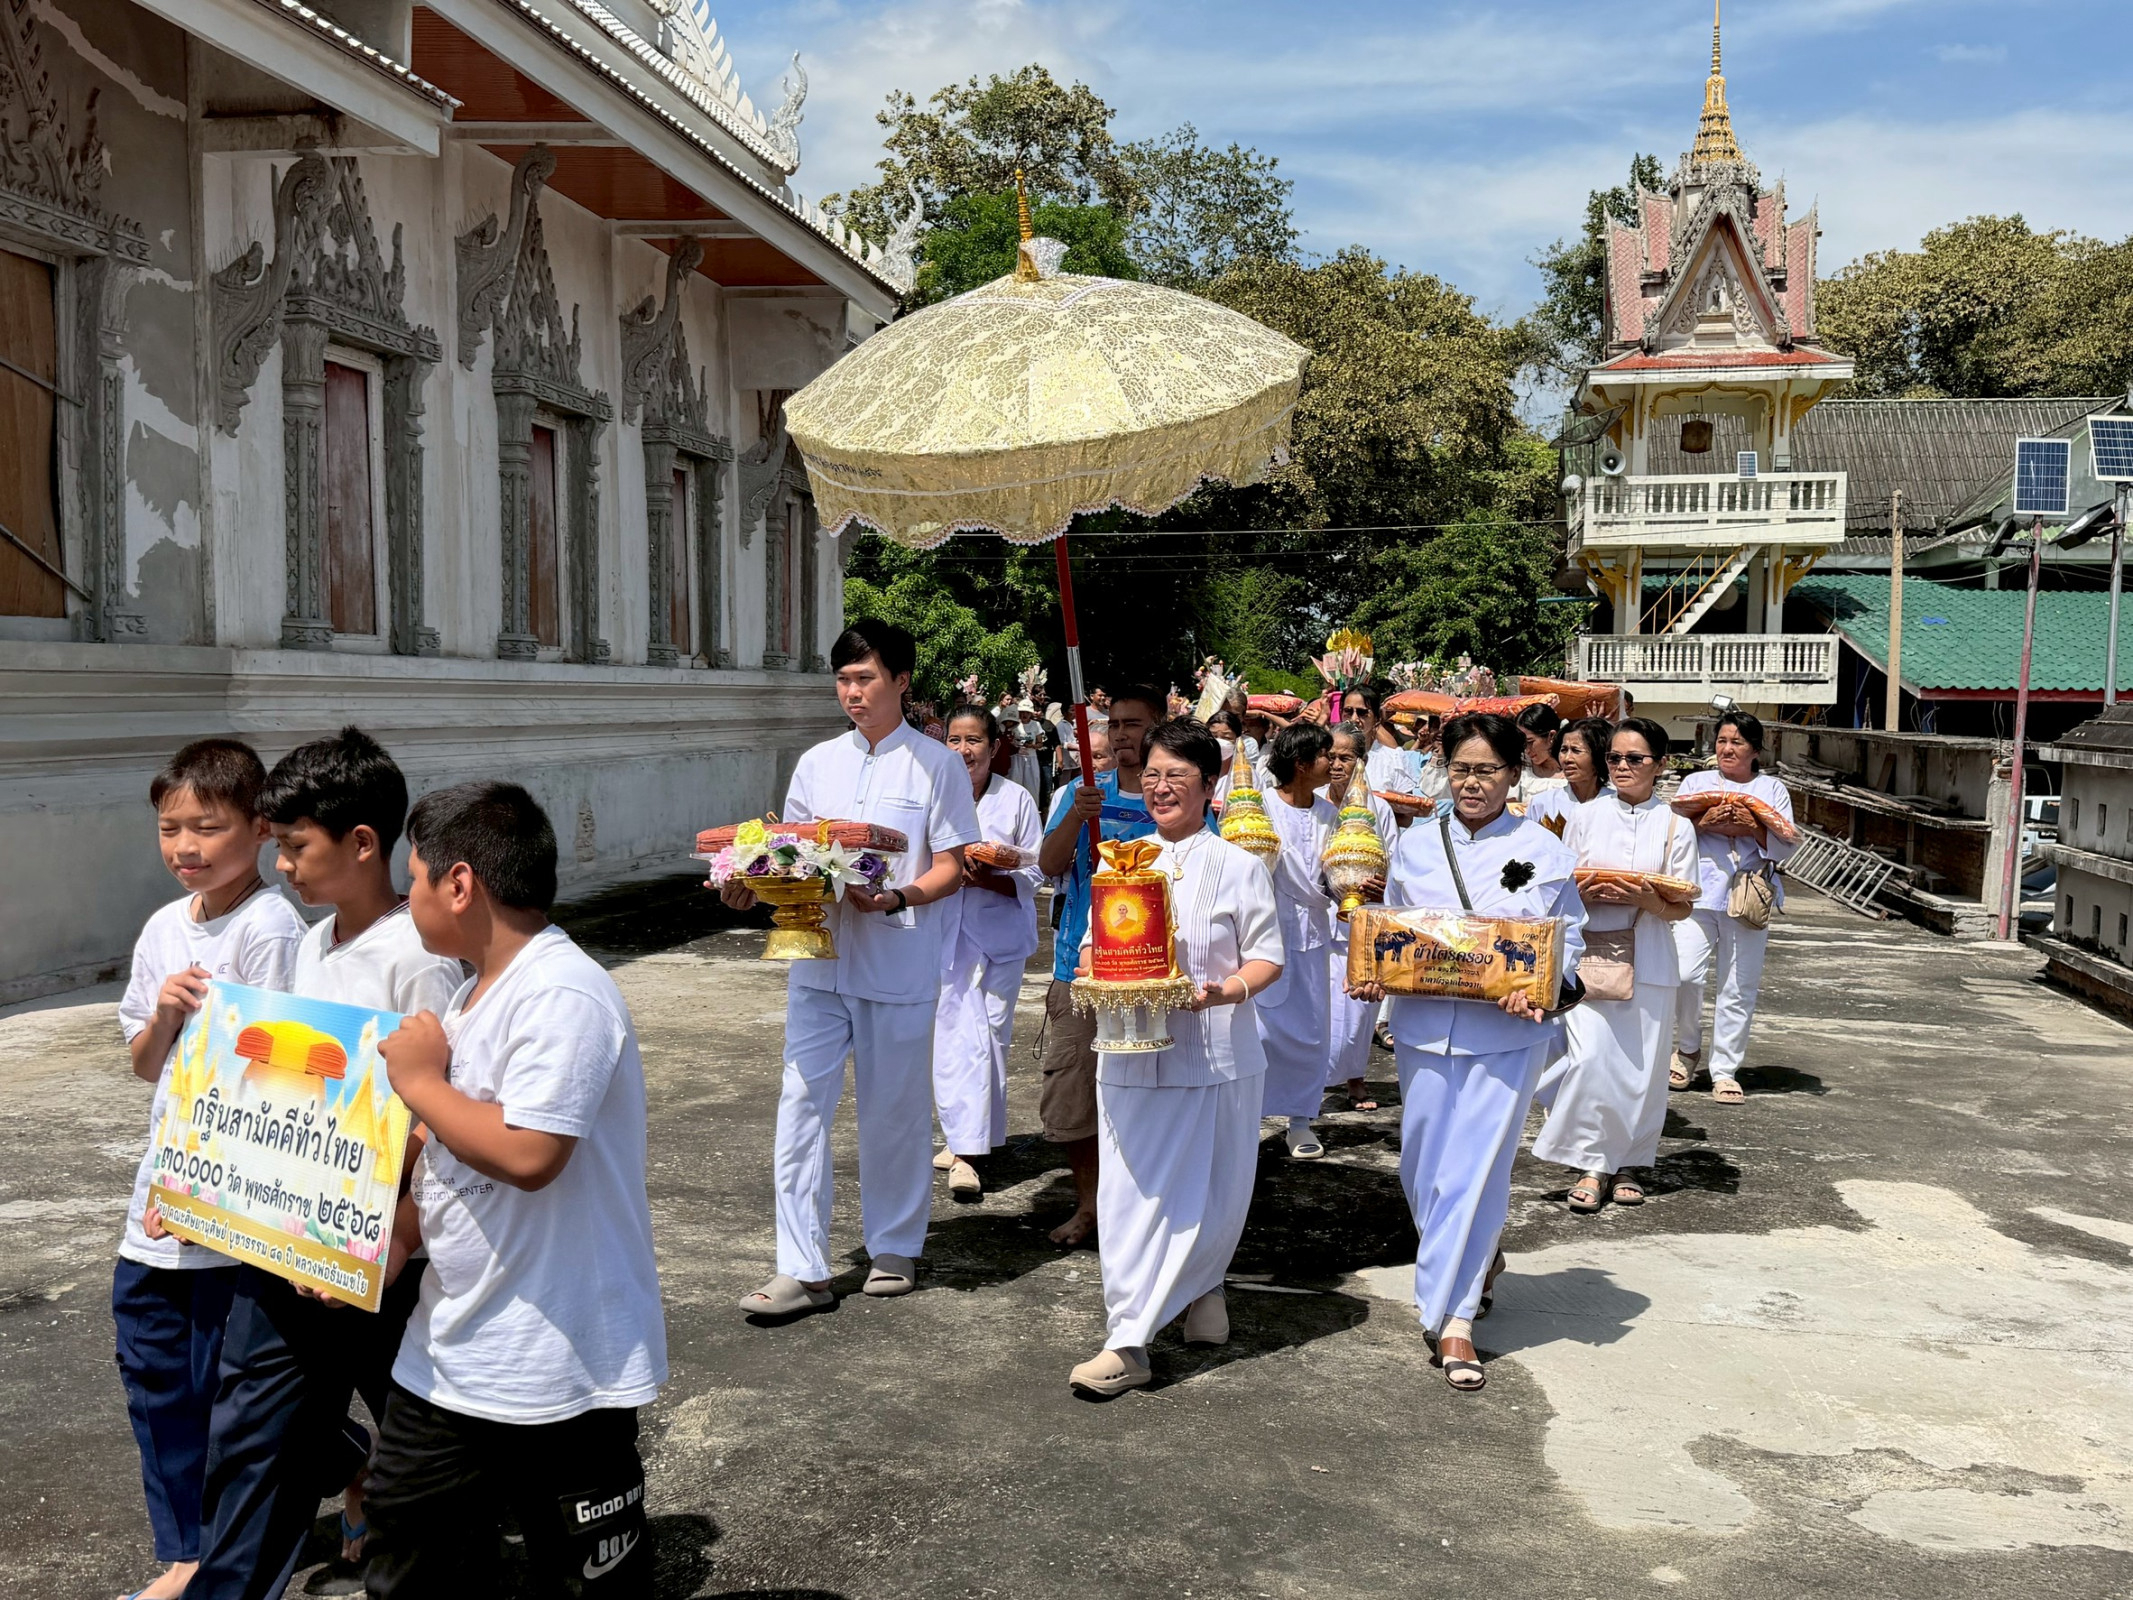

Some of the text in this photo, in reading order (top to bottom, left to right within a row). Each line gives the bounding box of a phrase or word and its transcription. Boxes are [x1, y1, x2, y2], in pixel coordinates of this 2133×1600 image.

[1414, 940, 1494, 964] ผ้าไตรครอง
[192, 1087, 366, 1173] กฐินสามัคคีทั่วไทย
[160, 1145, 384, 1243] ๓๐,๐๐๐ วัด พุทธศักราช ๒๕๖๘
[453, 1183, 494, 1199] CENTER
[168, 1207, 228, 1241] คณะศิษยานุศิษย์
[229, 1226, 268, 1256] บูชาธรรม
[285, 1241, 294, 1265] ปี
[295, 1255, 369, 1295] หลวงพ่อธัมมชโย
[599, 1530, 631, 1563] BOY
